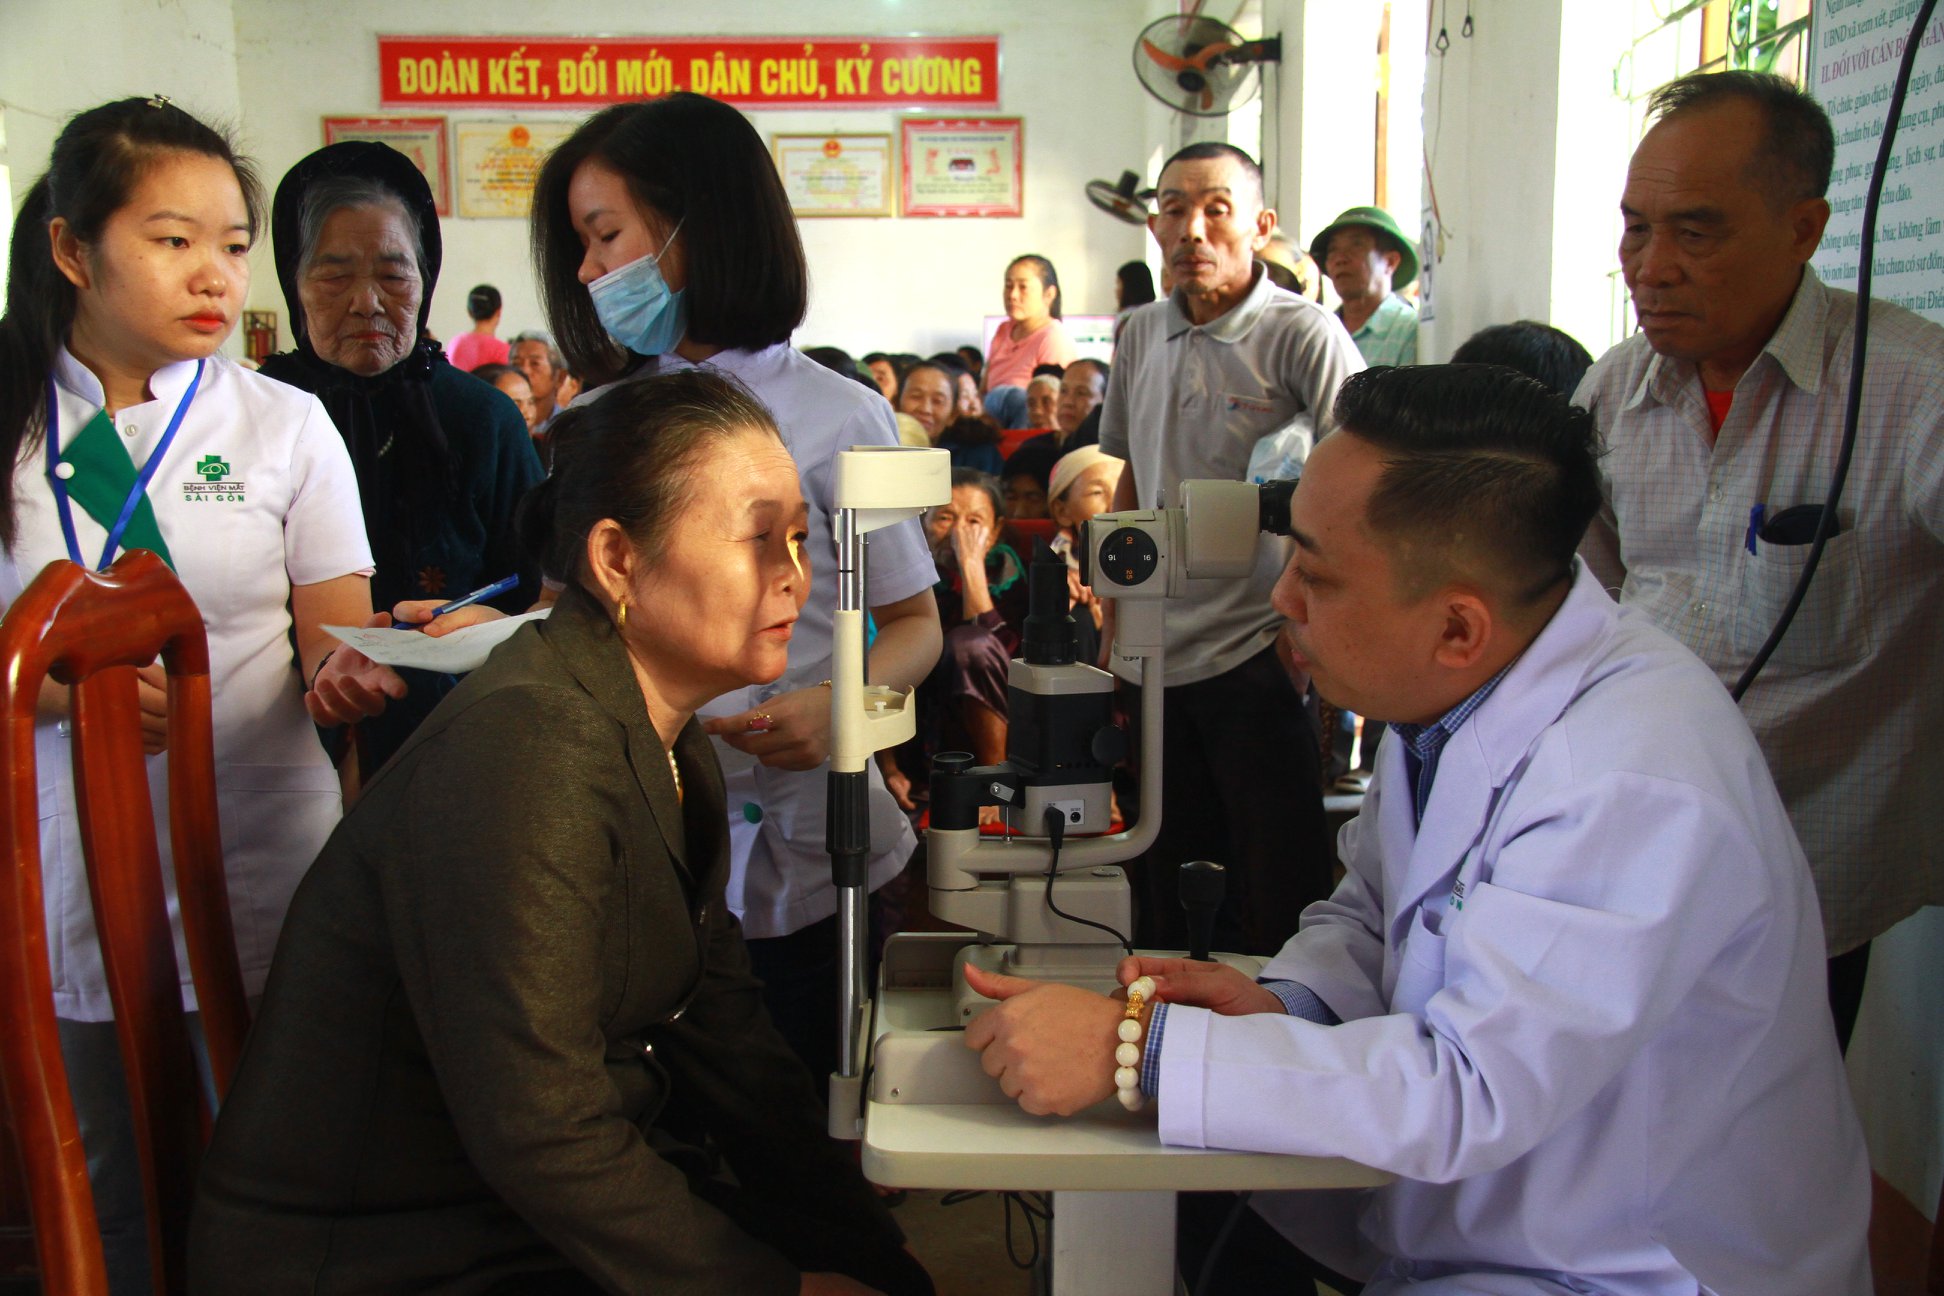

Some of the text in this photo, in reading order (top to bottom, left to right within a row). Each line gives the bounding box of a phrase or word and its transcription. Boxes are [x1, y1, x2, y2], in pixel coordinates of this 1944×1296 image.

[1824, 25, 1846, 48] UBND
[1857, 17, 1873, 35] xem
[399, 52, 478, 94] ĐOÀN
[489, 47, 550, 100] KẾT,
[558, 45, 606, 95] ĐỔI
[690, 50, 751, 94] DÂN
[759, 45, 827, 99] CHỦ,
[835, 43, 872, 95] KỶ
[883, 55, 981, 94] CƯƠNG
[1832, 50, 1850, 80] ĐỐI
[1851, 45, 1869, 74] VỚI
